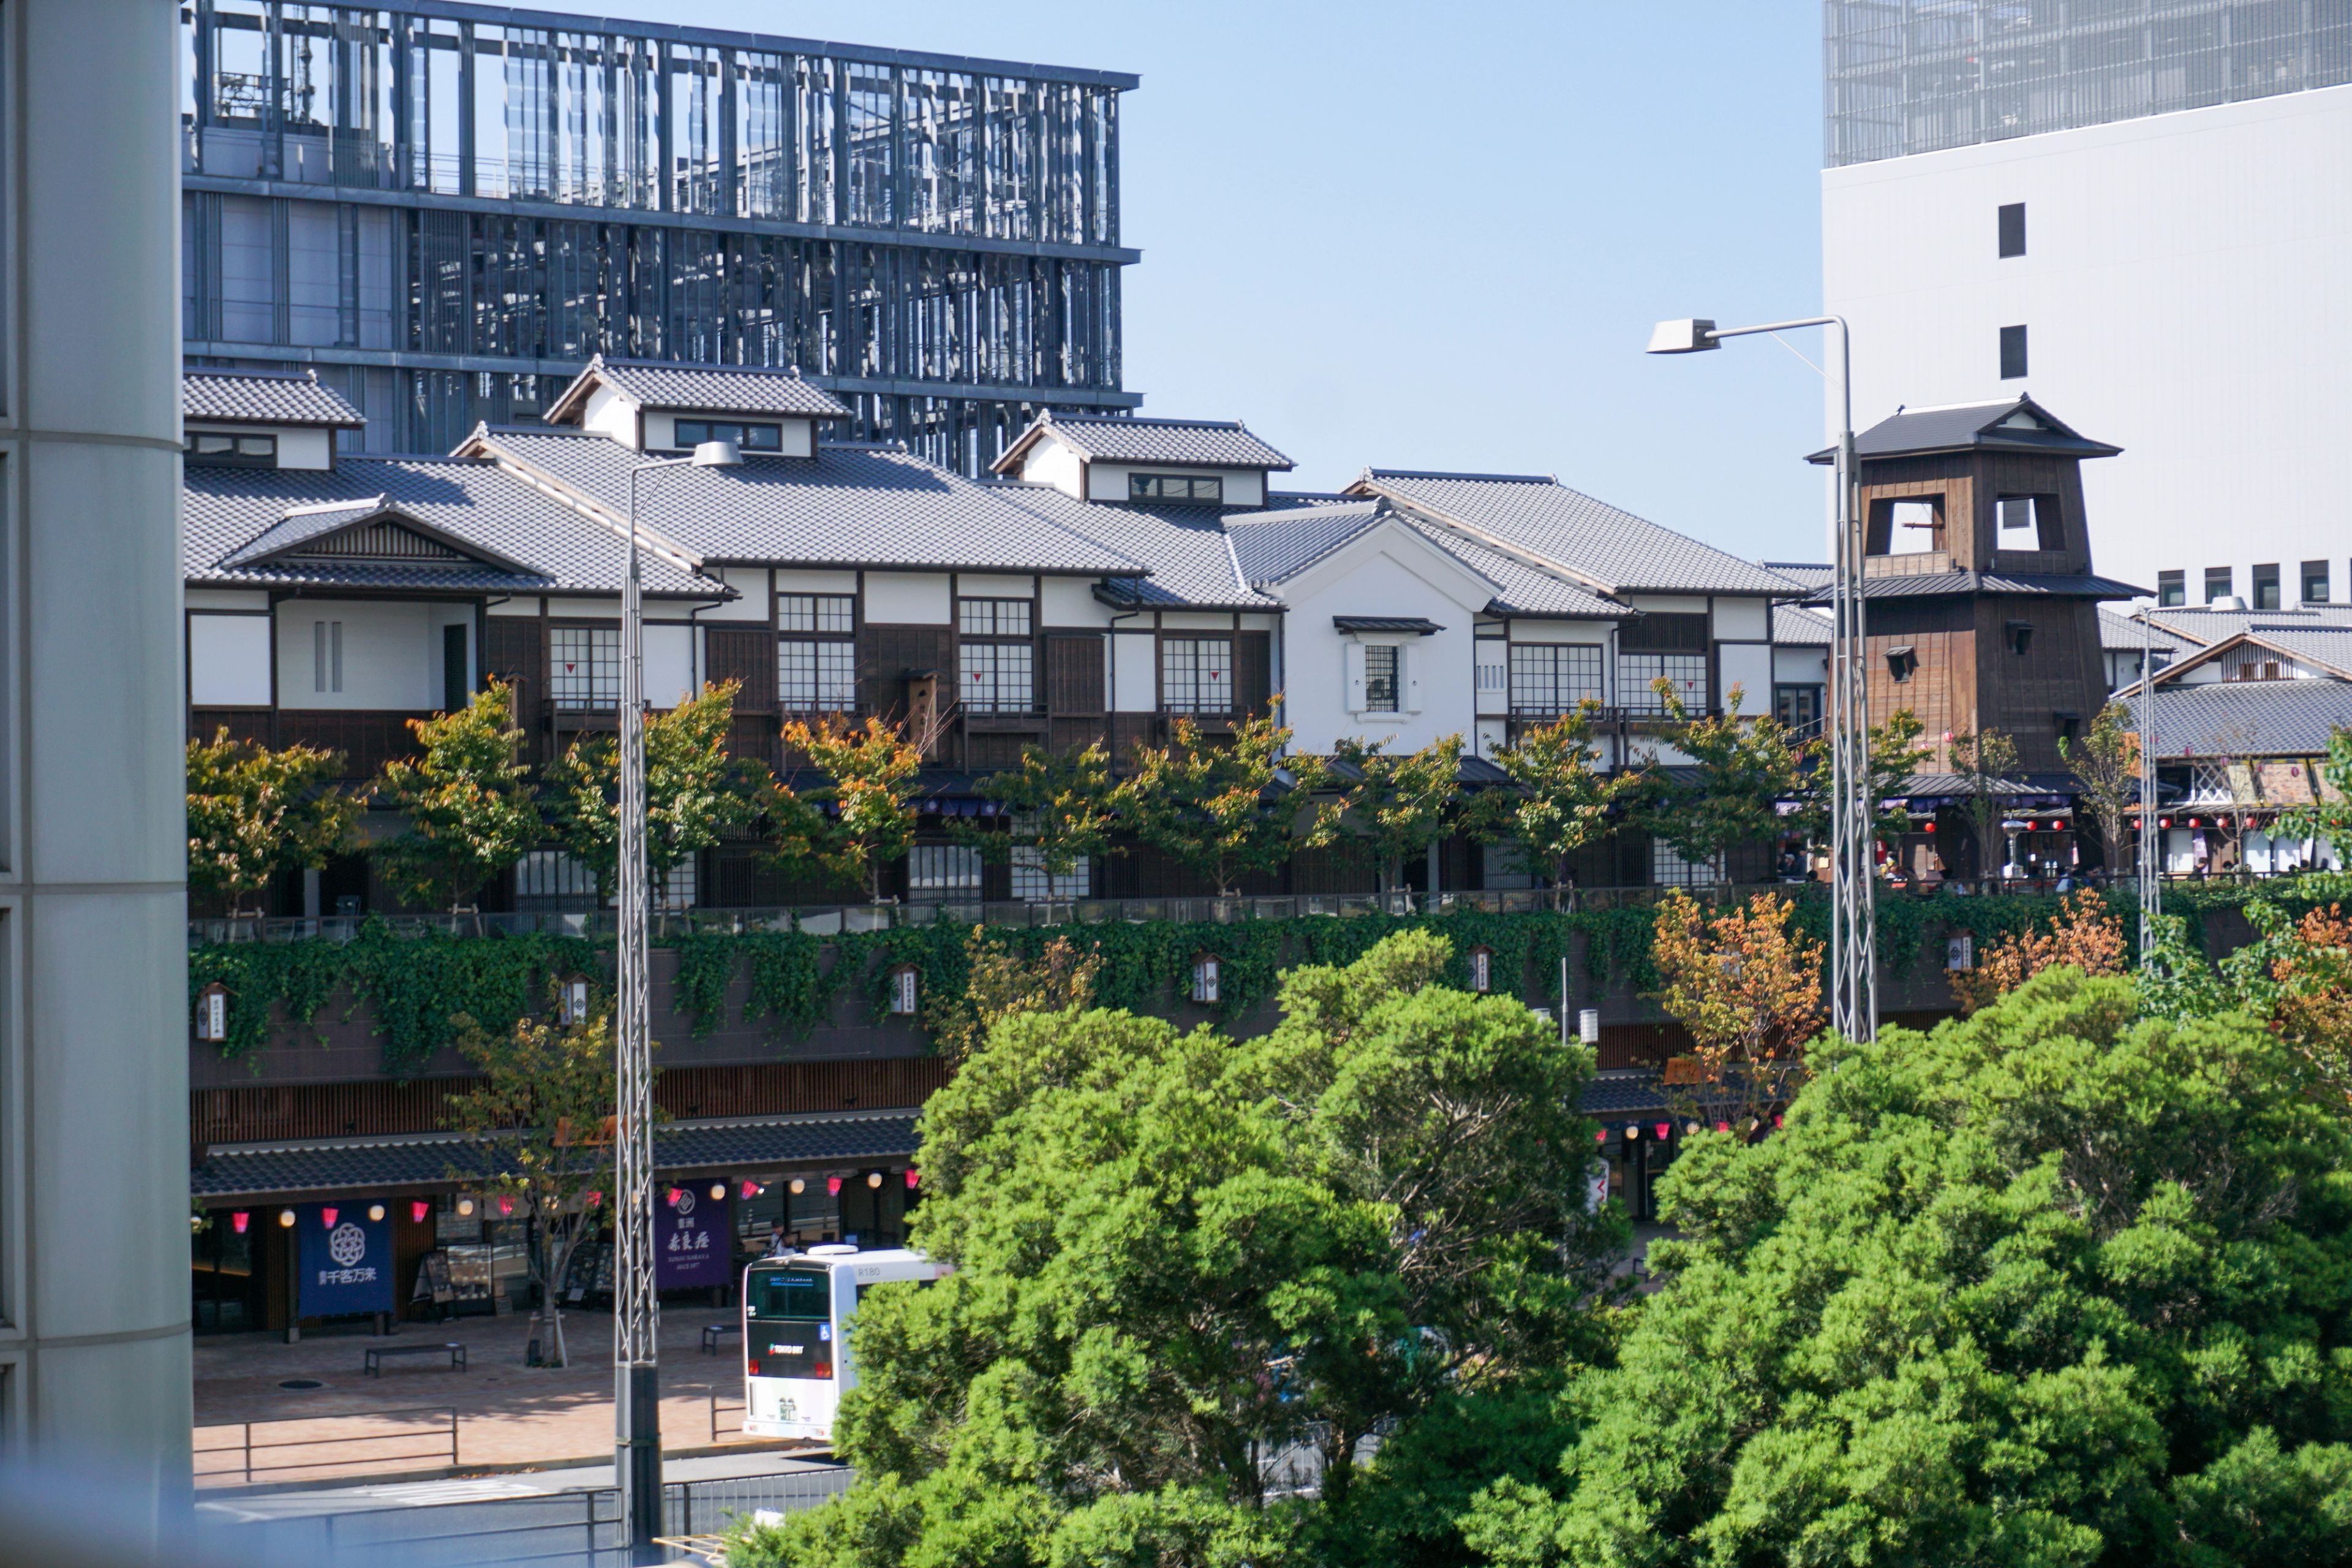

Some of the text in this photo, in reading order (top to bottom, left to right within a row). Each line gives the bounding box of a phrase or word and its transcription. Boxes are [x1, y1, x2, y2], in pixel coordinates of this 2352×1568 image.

[327, 1267, 377, 1284] 千客万来
[858, 1267, 881, 1276] R180
